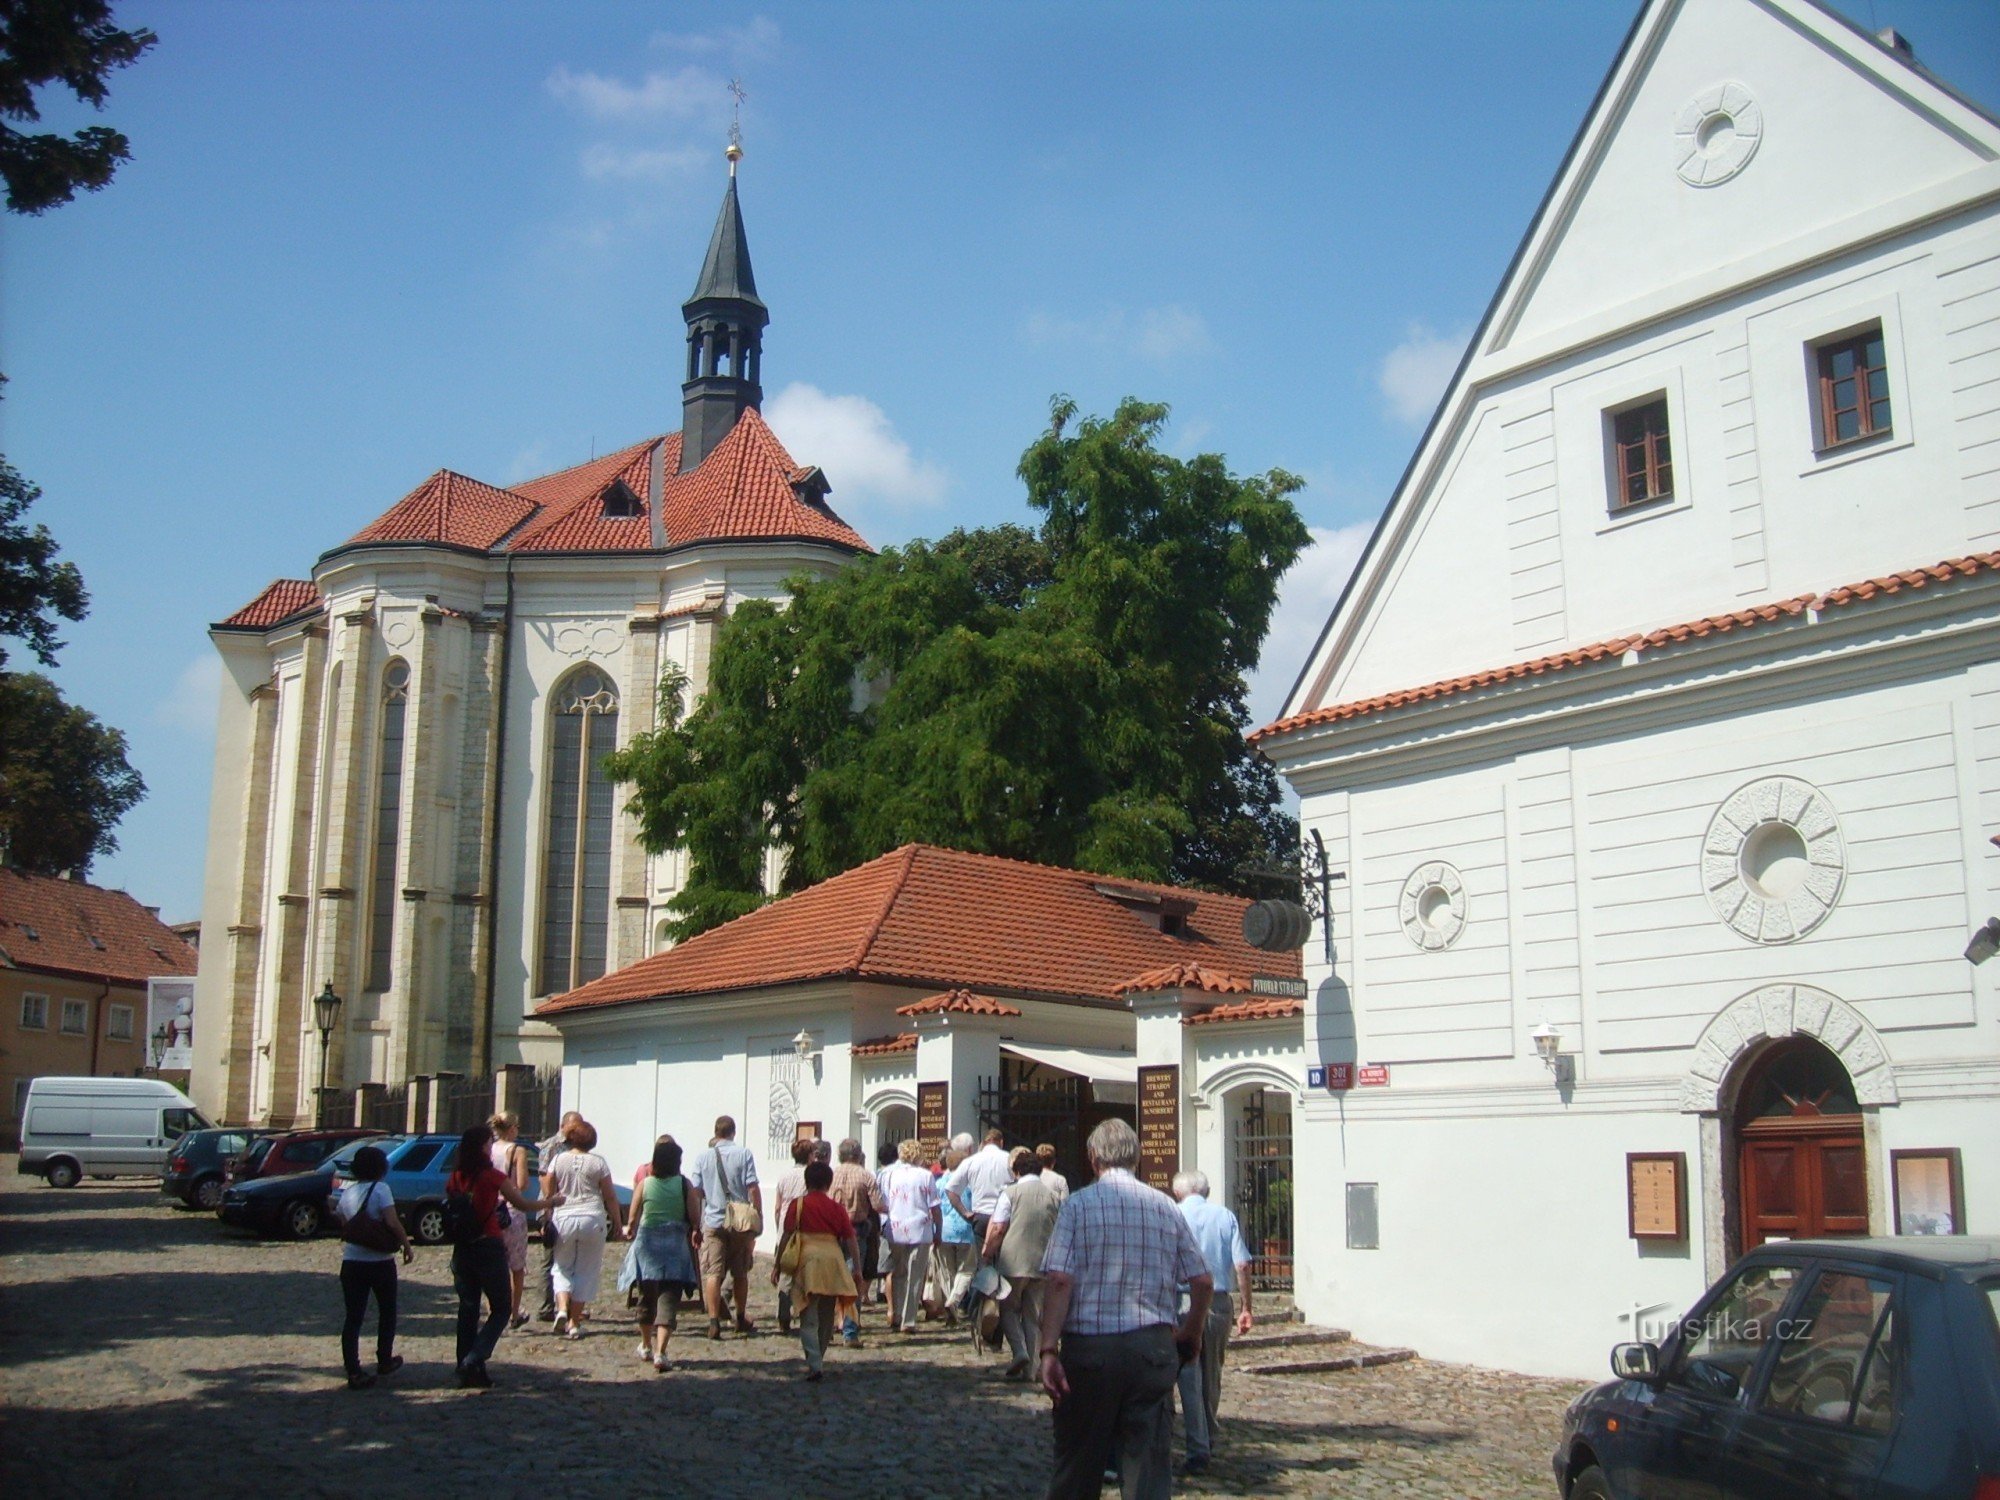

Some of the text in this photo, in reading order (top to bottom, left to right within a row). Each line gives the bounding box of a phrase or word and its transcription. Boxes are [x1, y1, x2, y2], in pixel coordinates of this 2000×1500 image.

[1253, 979, 1306, 996] PIVOVAR STRAHOV
[1332, 1066, 1346, 1078] 301
[1311, 1072, 1320, 1084] 10
[1142, 1099, 1176, 1107] RESTAURANT
[1142, 1148, 1157, 1156] DARK
[1149, 1172, 1168, 1180] CZECH
